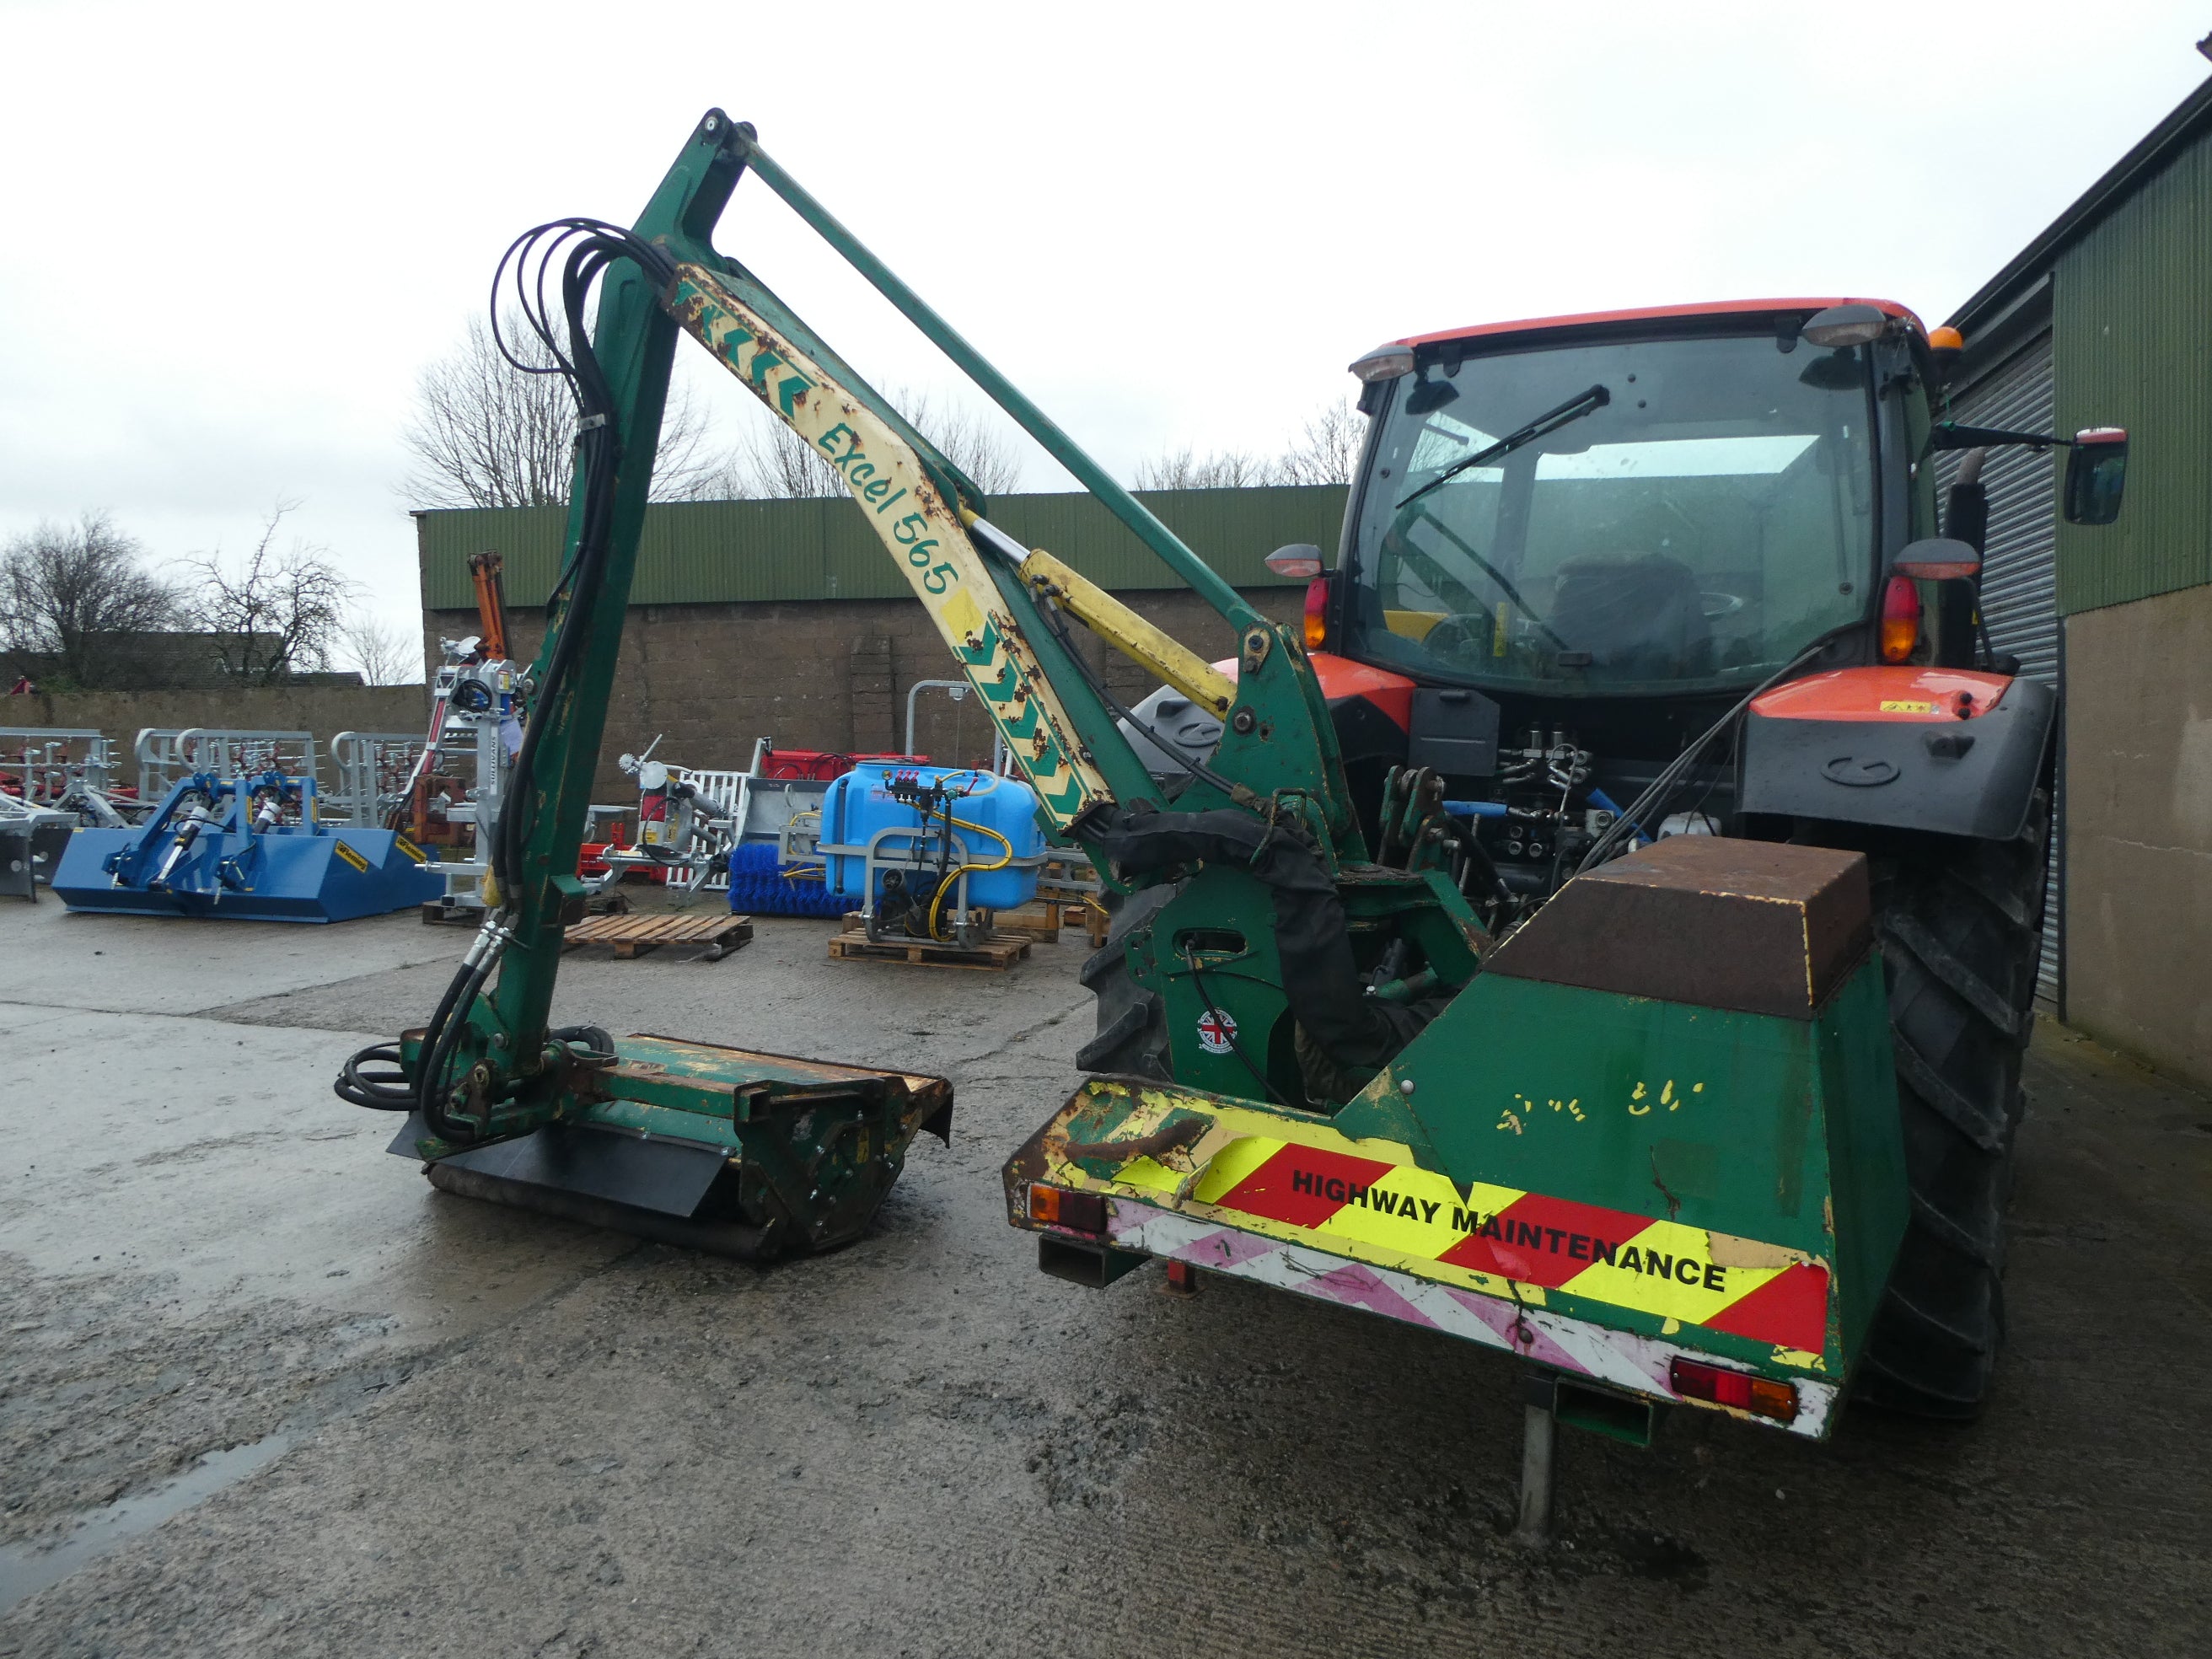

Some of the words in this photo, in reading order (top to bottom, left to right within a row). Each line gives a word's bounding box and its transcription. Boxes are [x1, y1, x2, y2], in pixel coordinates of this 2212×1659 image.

[818, 422, 907, 514] Excel
[893, 512, 959, 594] 565
[1292, 1169, 1442, 1225] HIGHWAY
[1451, 1205, 1726, 1293] MAINTENANCE
